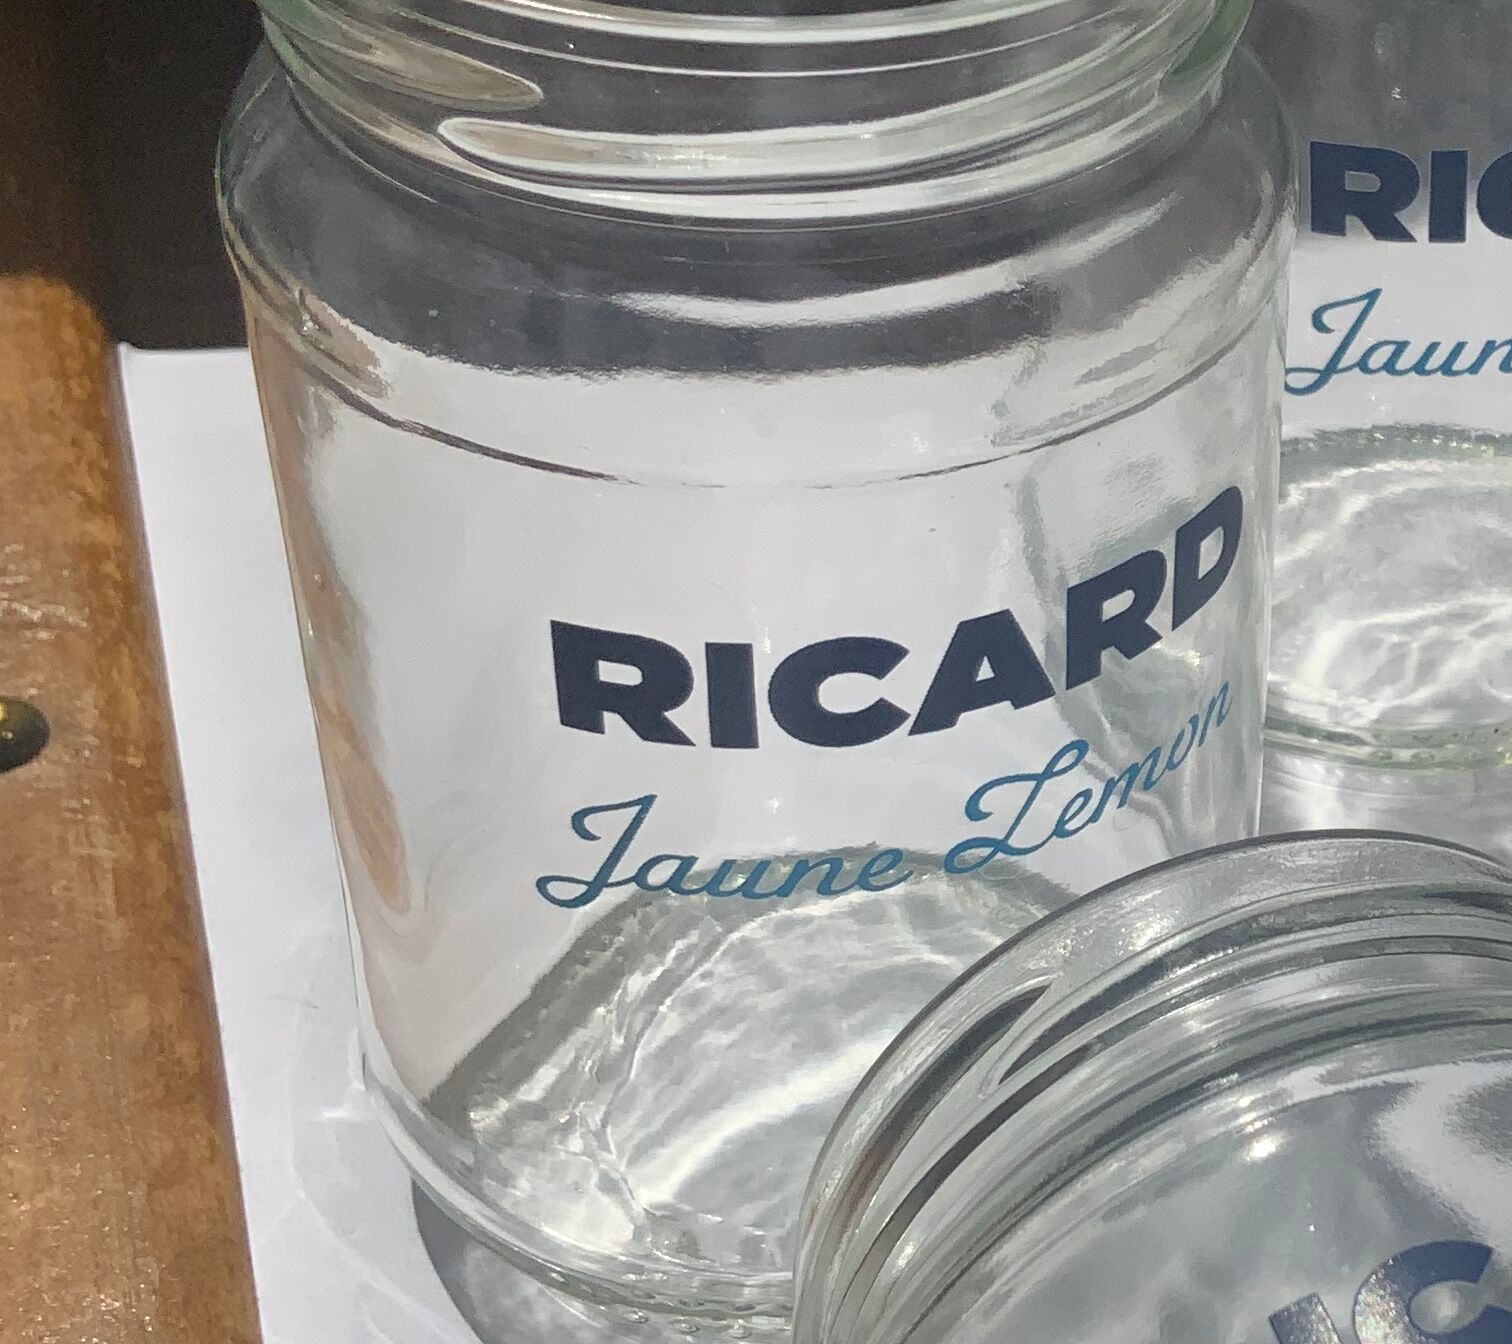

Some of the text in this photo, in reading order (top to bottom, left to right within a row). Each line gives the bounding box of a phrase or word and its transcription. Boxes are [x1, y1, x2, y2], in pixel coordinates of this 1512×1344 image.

[550, 485, 1243, 749] RICARD
[535, 679, 1231, 910] Jaune Lemon
